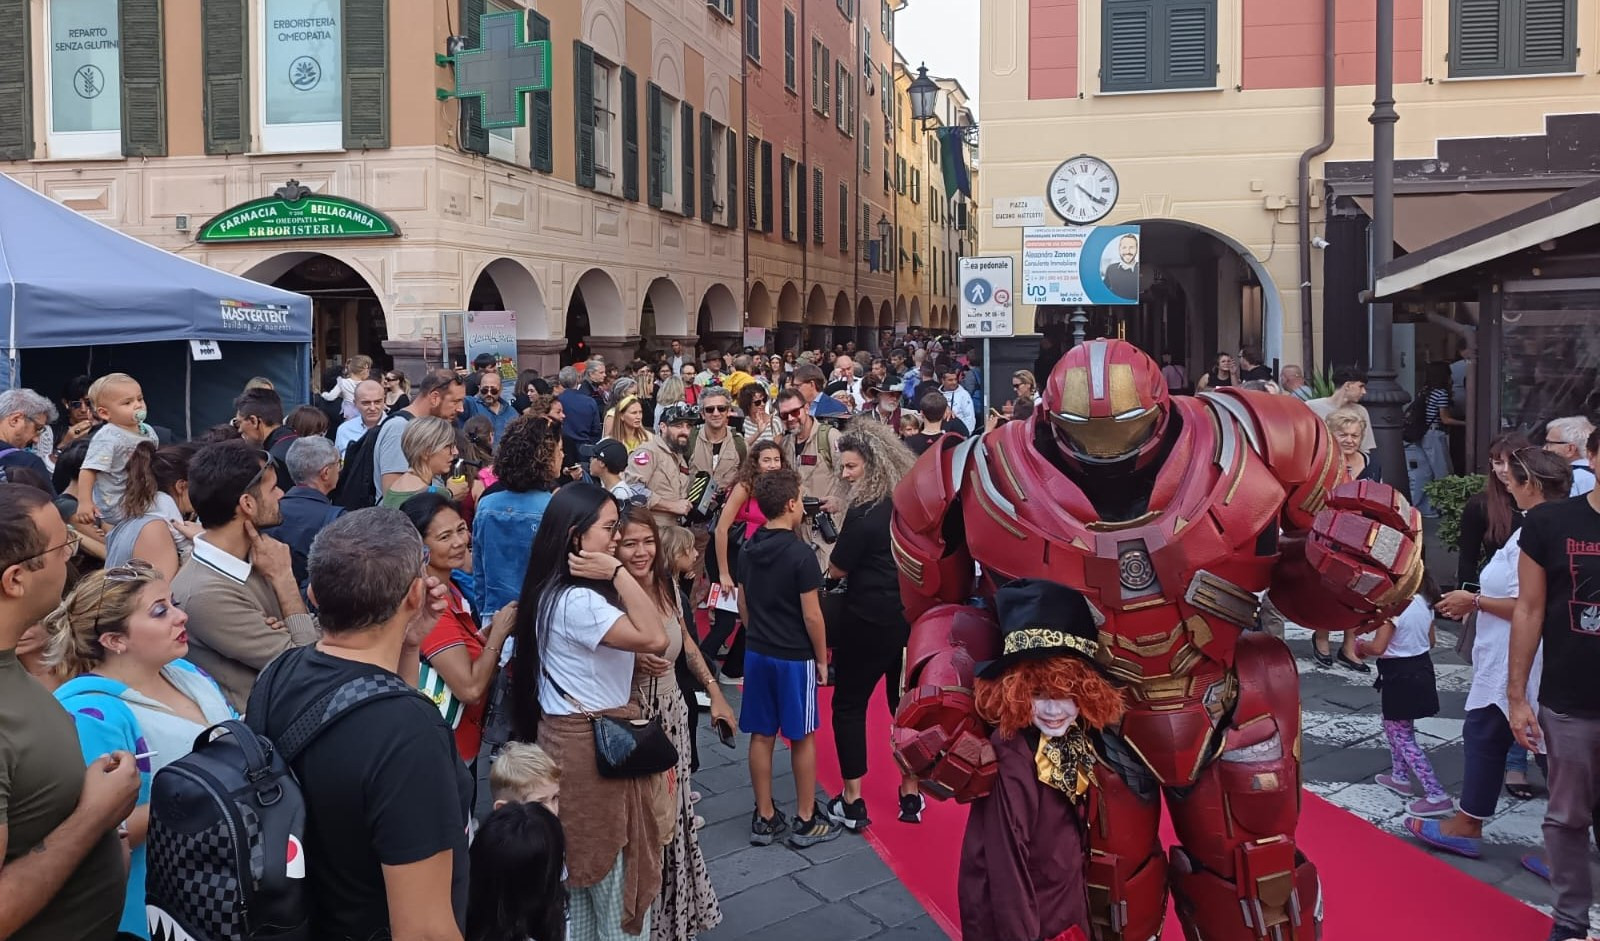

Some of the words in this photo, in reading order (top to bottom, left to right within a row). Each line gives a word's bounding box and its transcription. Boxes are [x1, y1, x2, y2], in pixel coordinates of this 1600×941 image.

[273, 17, 336, 29] ERBORISTERIA
[68, 28, 108, 38] REPARTO
[278, 31, 331, 42] OMEOPATIA
[55, 41, 83, 52] SENZA
[219, 206, 277, 232] FARMACIA
[311, 204, 375, 228] BELLAGAMBA
[275, 216, 318, 224] OMEOPATIA
[249, 224, 344, 237] ERBORISTERIA
[979, 261, 1009, 271] pedonale
[221, 306, 289, 324] MASTERTENT
[223, 321, 251, 331] building
